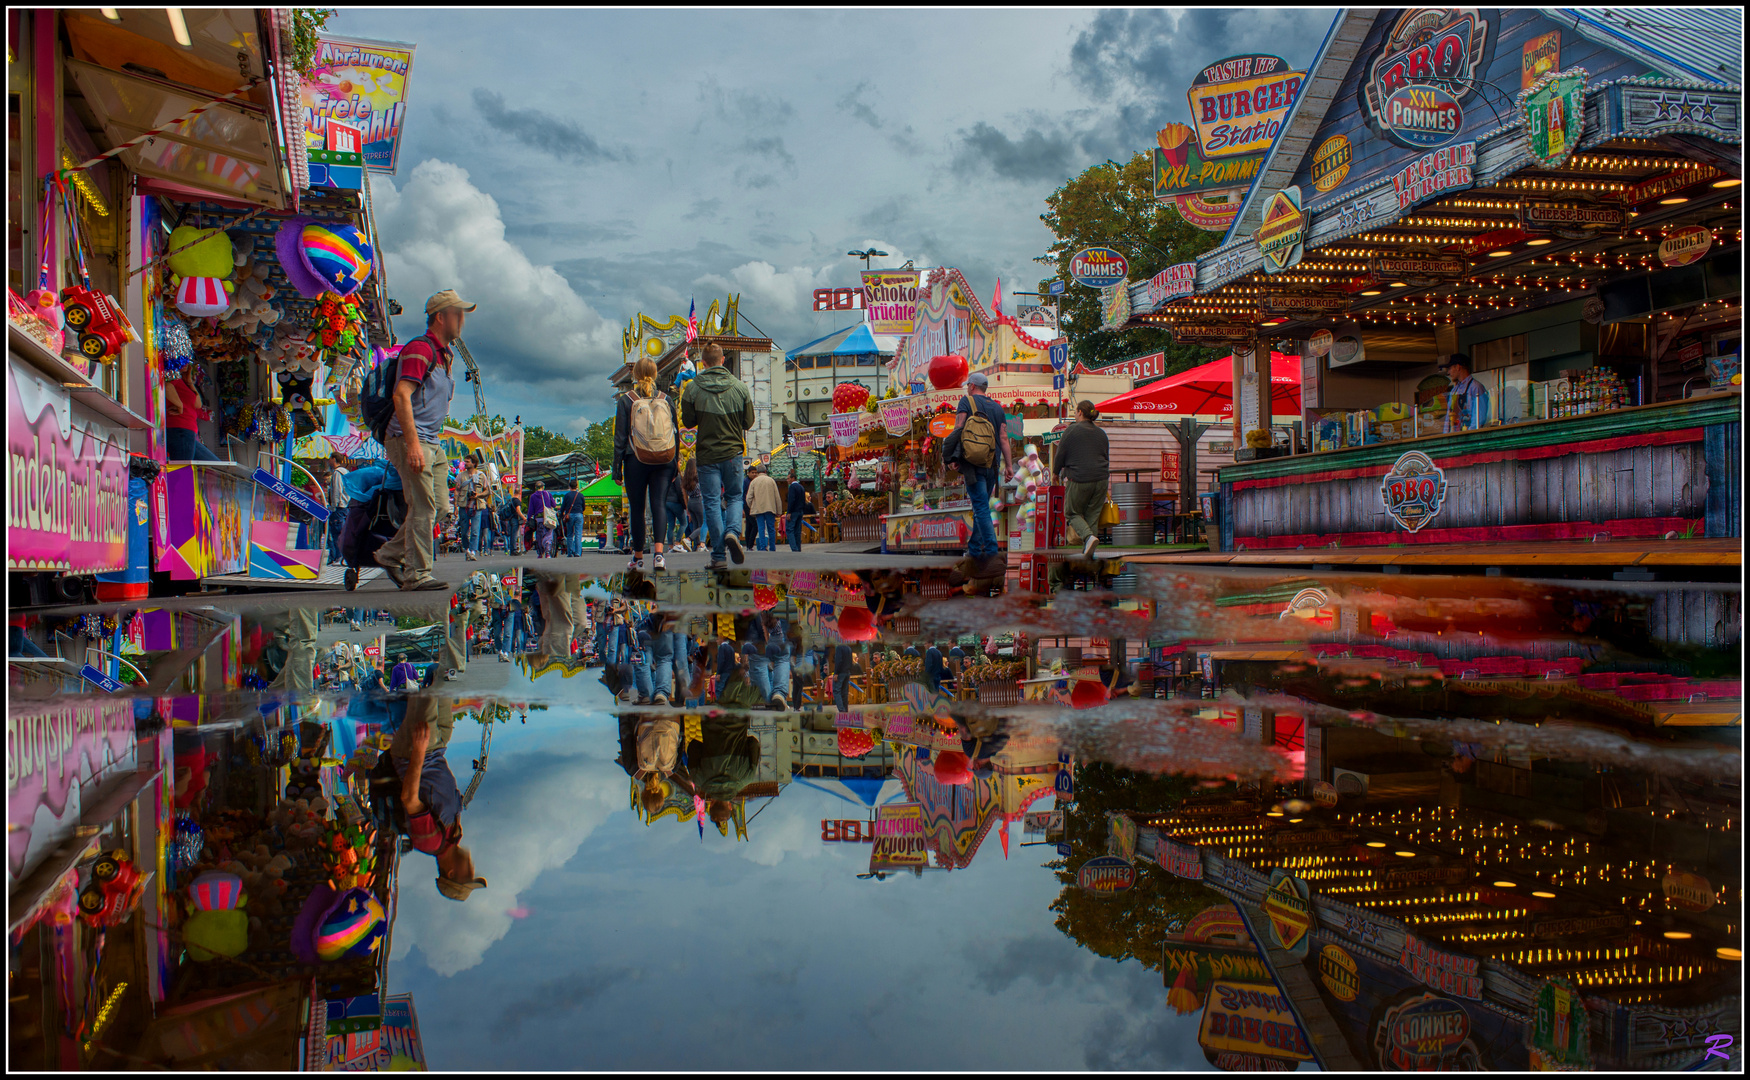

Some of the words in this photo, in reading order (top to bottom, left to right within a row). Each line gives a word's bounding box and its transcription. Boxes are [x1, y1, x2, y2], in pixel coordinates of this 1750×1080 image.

[1524, 35, 1558, 72] BURGERS
[1204, 58, 1252, 83] TASTE
[1253, 57, 1279, 75] IT!
[313, 93, 372, 119] Freie
[1199, 76, 1302, 124] BURGER
[1409, 88, 1439, 109] XXL
[303, 102, 405, 145] Auahl!
[1393, 100, 1456, 131] POMMES
[1204, 117, 1281, 152] Statio
[1314, 147, 1349, 179] GARAGE
[1392, 142, 1476, 195] VEGGIE
[1156, 157, 1266, 191] XXL-POMME
[1399, 166, 1473, 211] BURGER
[1665, 232, 1705, 253] ORDER
[1087, 250, 1110, 263] XXL
[1075, 259, 1124, 277] POMMES
[1148, 262, 1197, 296] CHICKEN
[865, 285, 917, 302] Schoko
[1151, 280, 1194, 306] BURGER
[868, 303, 916, 321] früchte
[1019, 305, 1056, 322] WELCOME
[1053, 347, 1064, 364] 10
[985, 389, 1064, 400] onnenblumenkerne
[884, 406, 909, 419] Schoko-
[833, 419, 858, 429] Zucker-
[834, 426, 857, 437] watte
[9, 434, 68, 535] ndeln
[505, 475, 517, 483] WC
[1163, 470, 1178, 480] OK
[271, 481, 285, 494] Für
[285, 491, 310, 509] Kinder
[1390, 478, 1439, 512] BBQ
[505, 577, 517, 585] WC
[367, 647, 380, 655] WC
[99, 677, 114, 691] Für
